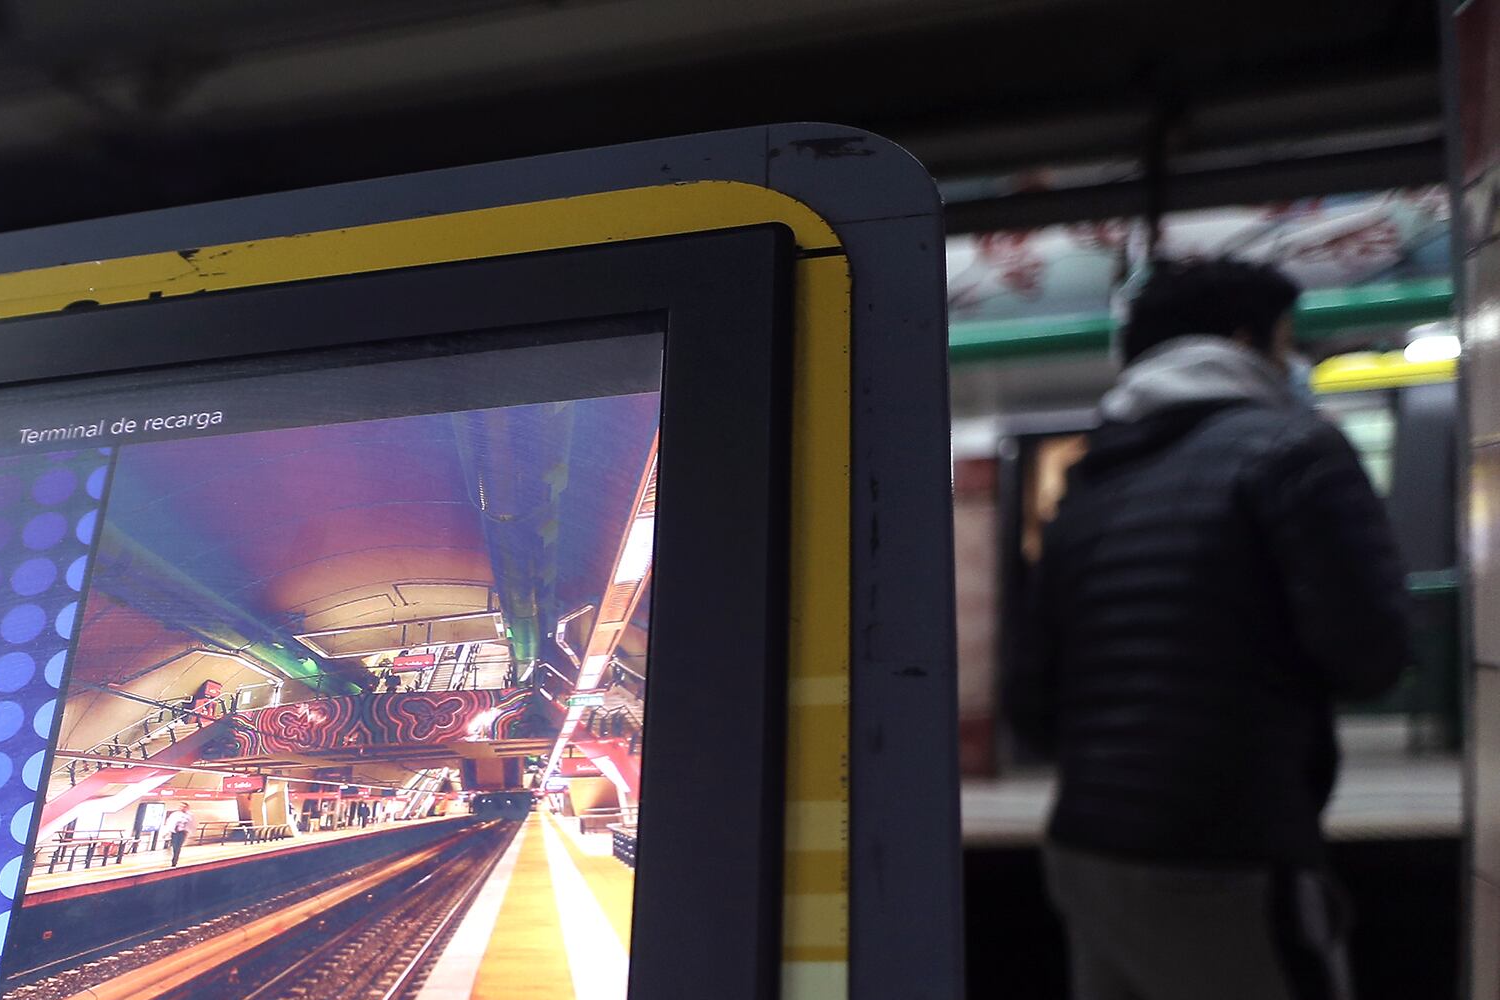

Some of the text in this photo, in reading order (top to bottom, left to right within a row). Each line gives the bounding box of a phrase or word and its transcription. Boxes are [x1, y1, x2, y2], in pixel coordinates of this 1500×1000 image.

[19, 410, 224, 444] Terminal de recarga
